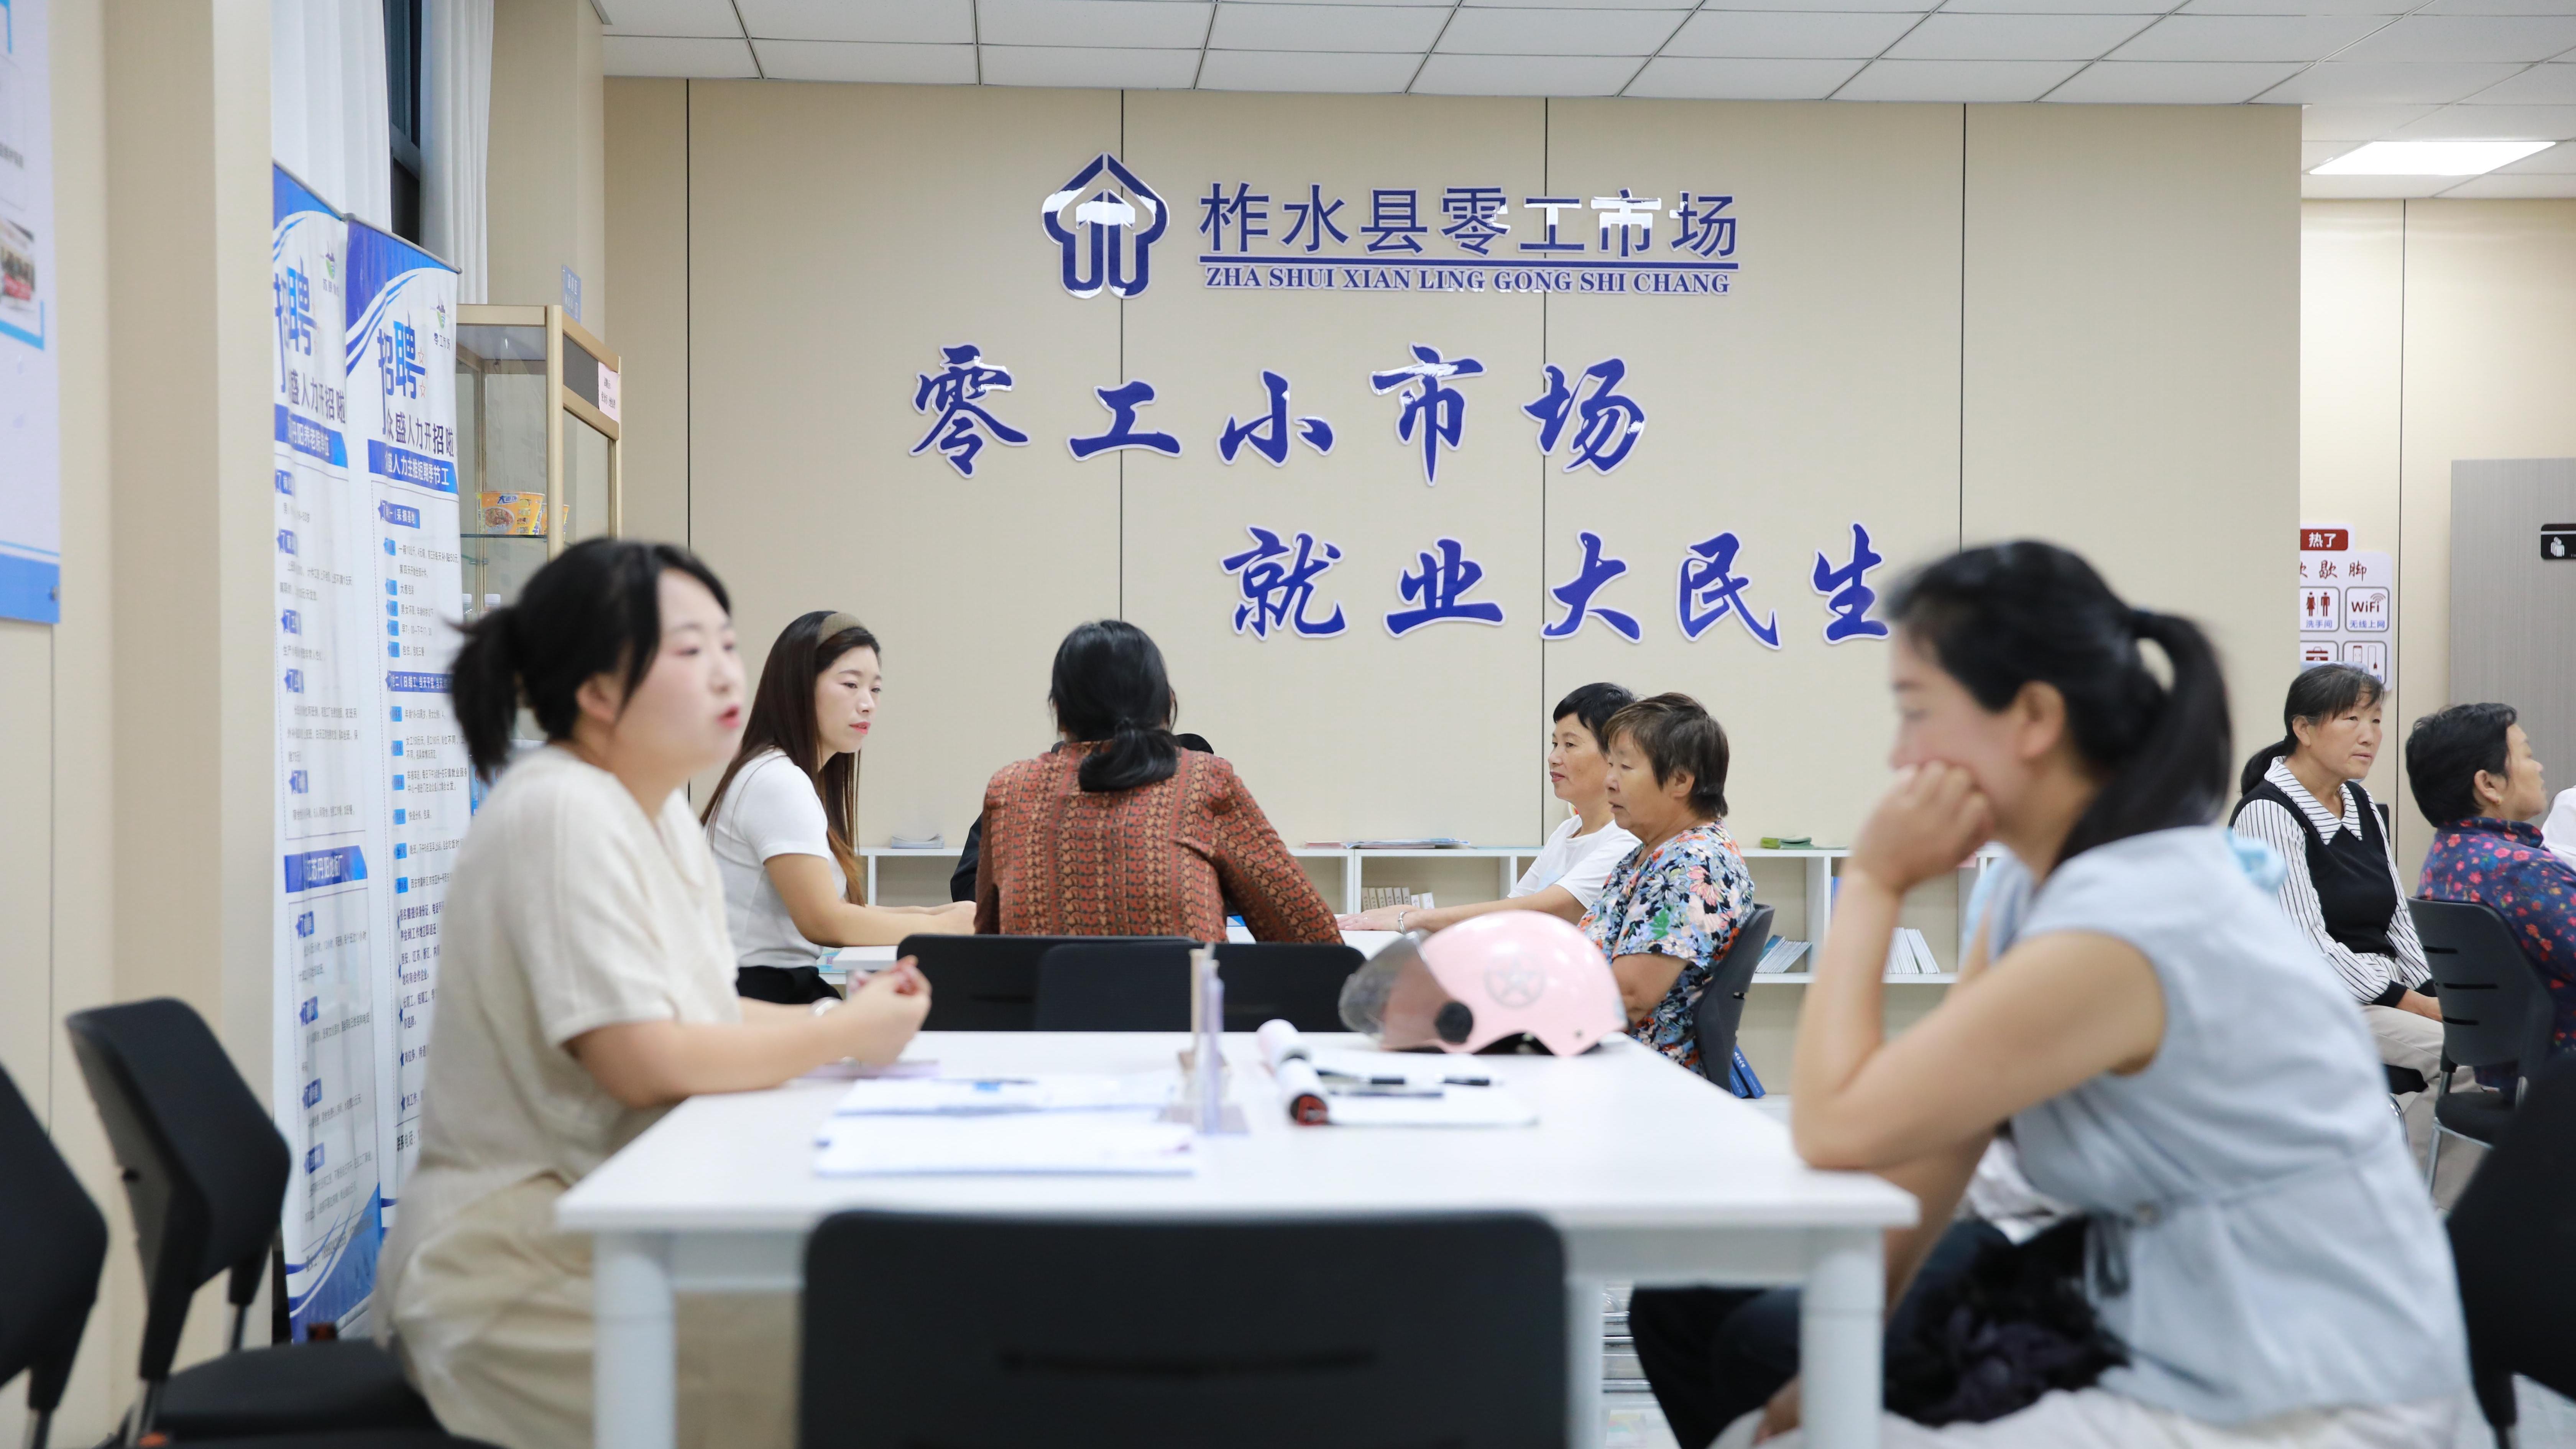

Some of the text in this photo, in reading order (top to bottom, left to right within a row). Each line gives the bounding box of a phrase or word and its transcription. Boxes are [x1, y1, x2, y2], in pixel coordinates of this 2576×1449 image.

[1201, 182, 1737, 256] 柞水县零工市场
[1207, 268, 1729, 293] ZHA SHUI XIAN LING GONG SHI CHANG
[273, 256, 317, 393] 招聘
[377, 310, 426, 435] 招聘
[386, 408, 454, 457] 众盛人力开招啦
[914, 345, 1644, 481] 零工小市场
[1223, 524, 1888, 645] 就业大民生
[2351, 600, 2379, 613] WiFi
[2306, 619, 2333, 629] 洗手间
[2349, 619, 2385, 629] 无线上网
